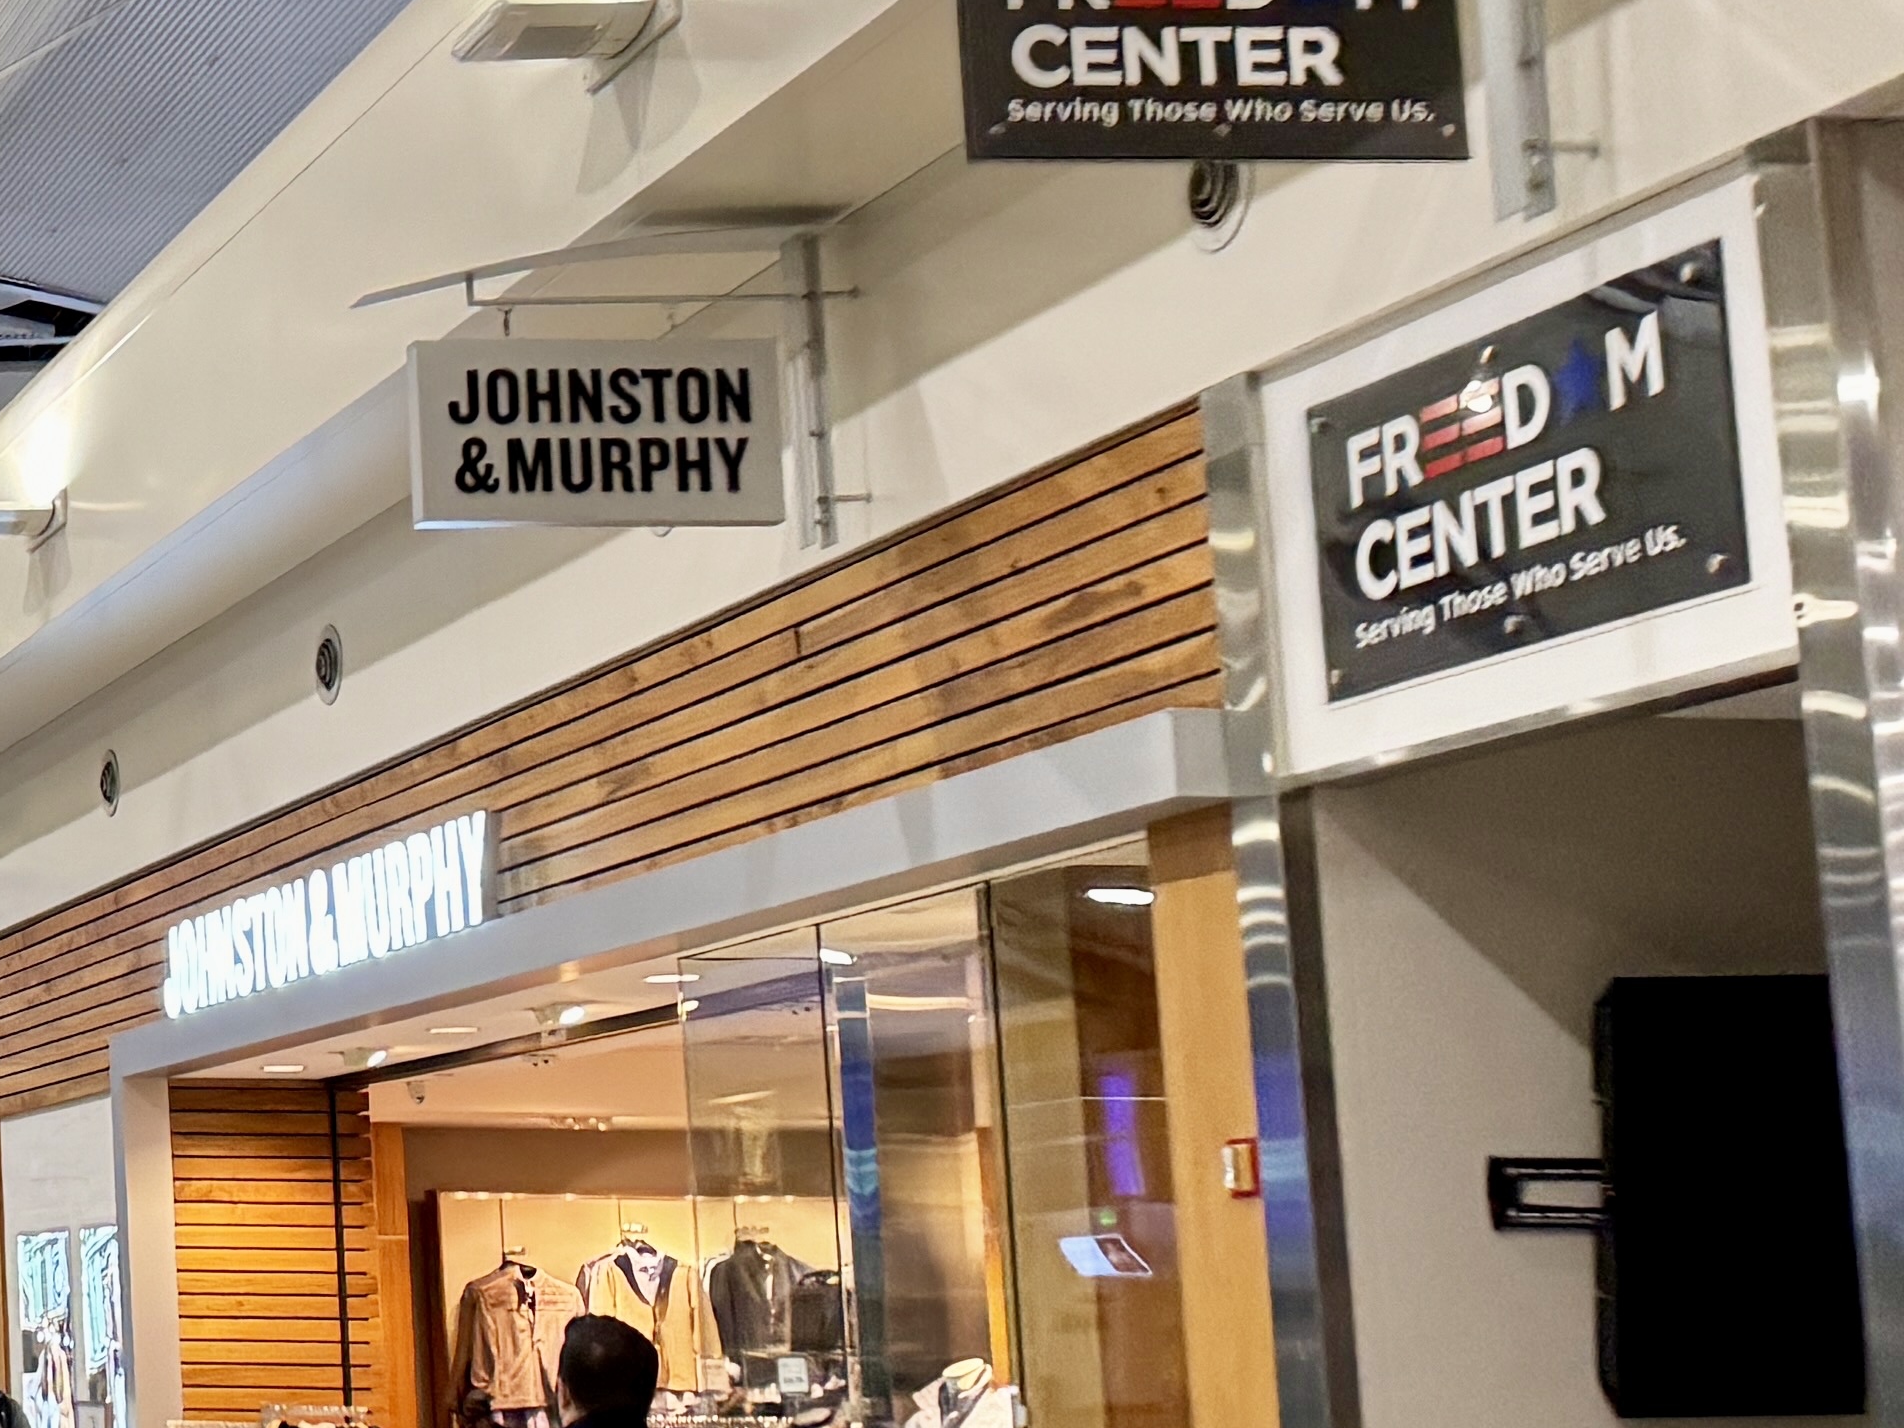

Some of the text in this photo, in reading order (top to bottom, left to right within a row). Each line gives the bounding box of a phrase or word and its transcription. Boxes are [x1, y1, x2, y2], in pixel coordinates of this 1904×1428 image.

[1011, 23, 1343, 88] CENTER
[1007, 97, 1120, 126] Serving
[1128, 98, 1217, 122] Those
[1224, 98, 1292, 122] Who
[1299, 99, 1382, 122] Serve
[447, 367, 751, 425] JOHNSTON
[1355, 446, 1607, 600] CENTER
[1355, 604, 1435, 649] Serving
[1438, 581, 1509, 622] Those
[1509, 562, 1567, 600] Who
[1569, 538, 1642, 581] Serve
[331, 809, 486, 968] MURPHY
